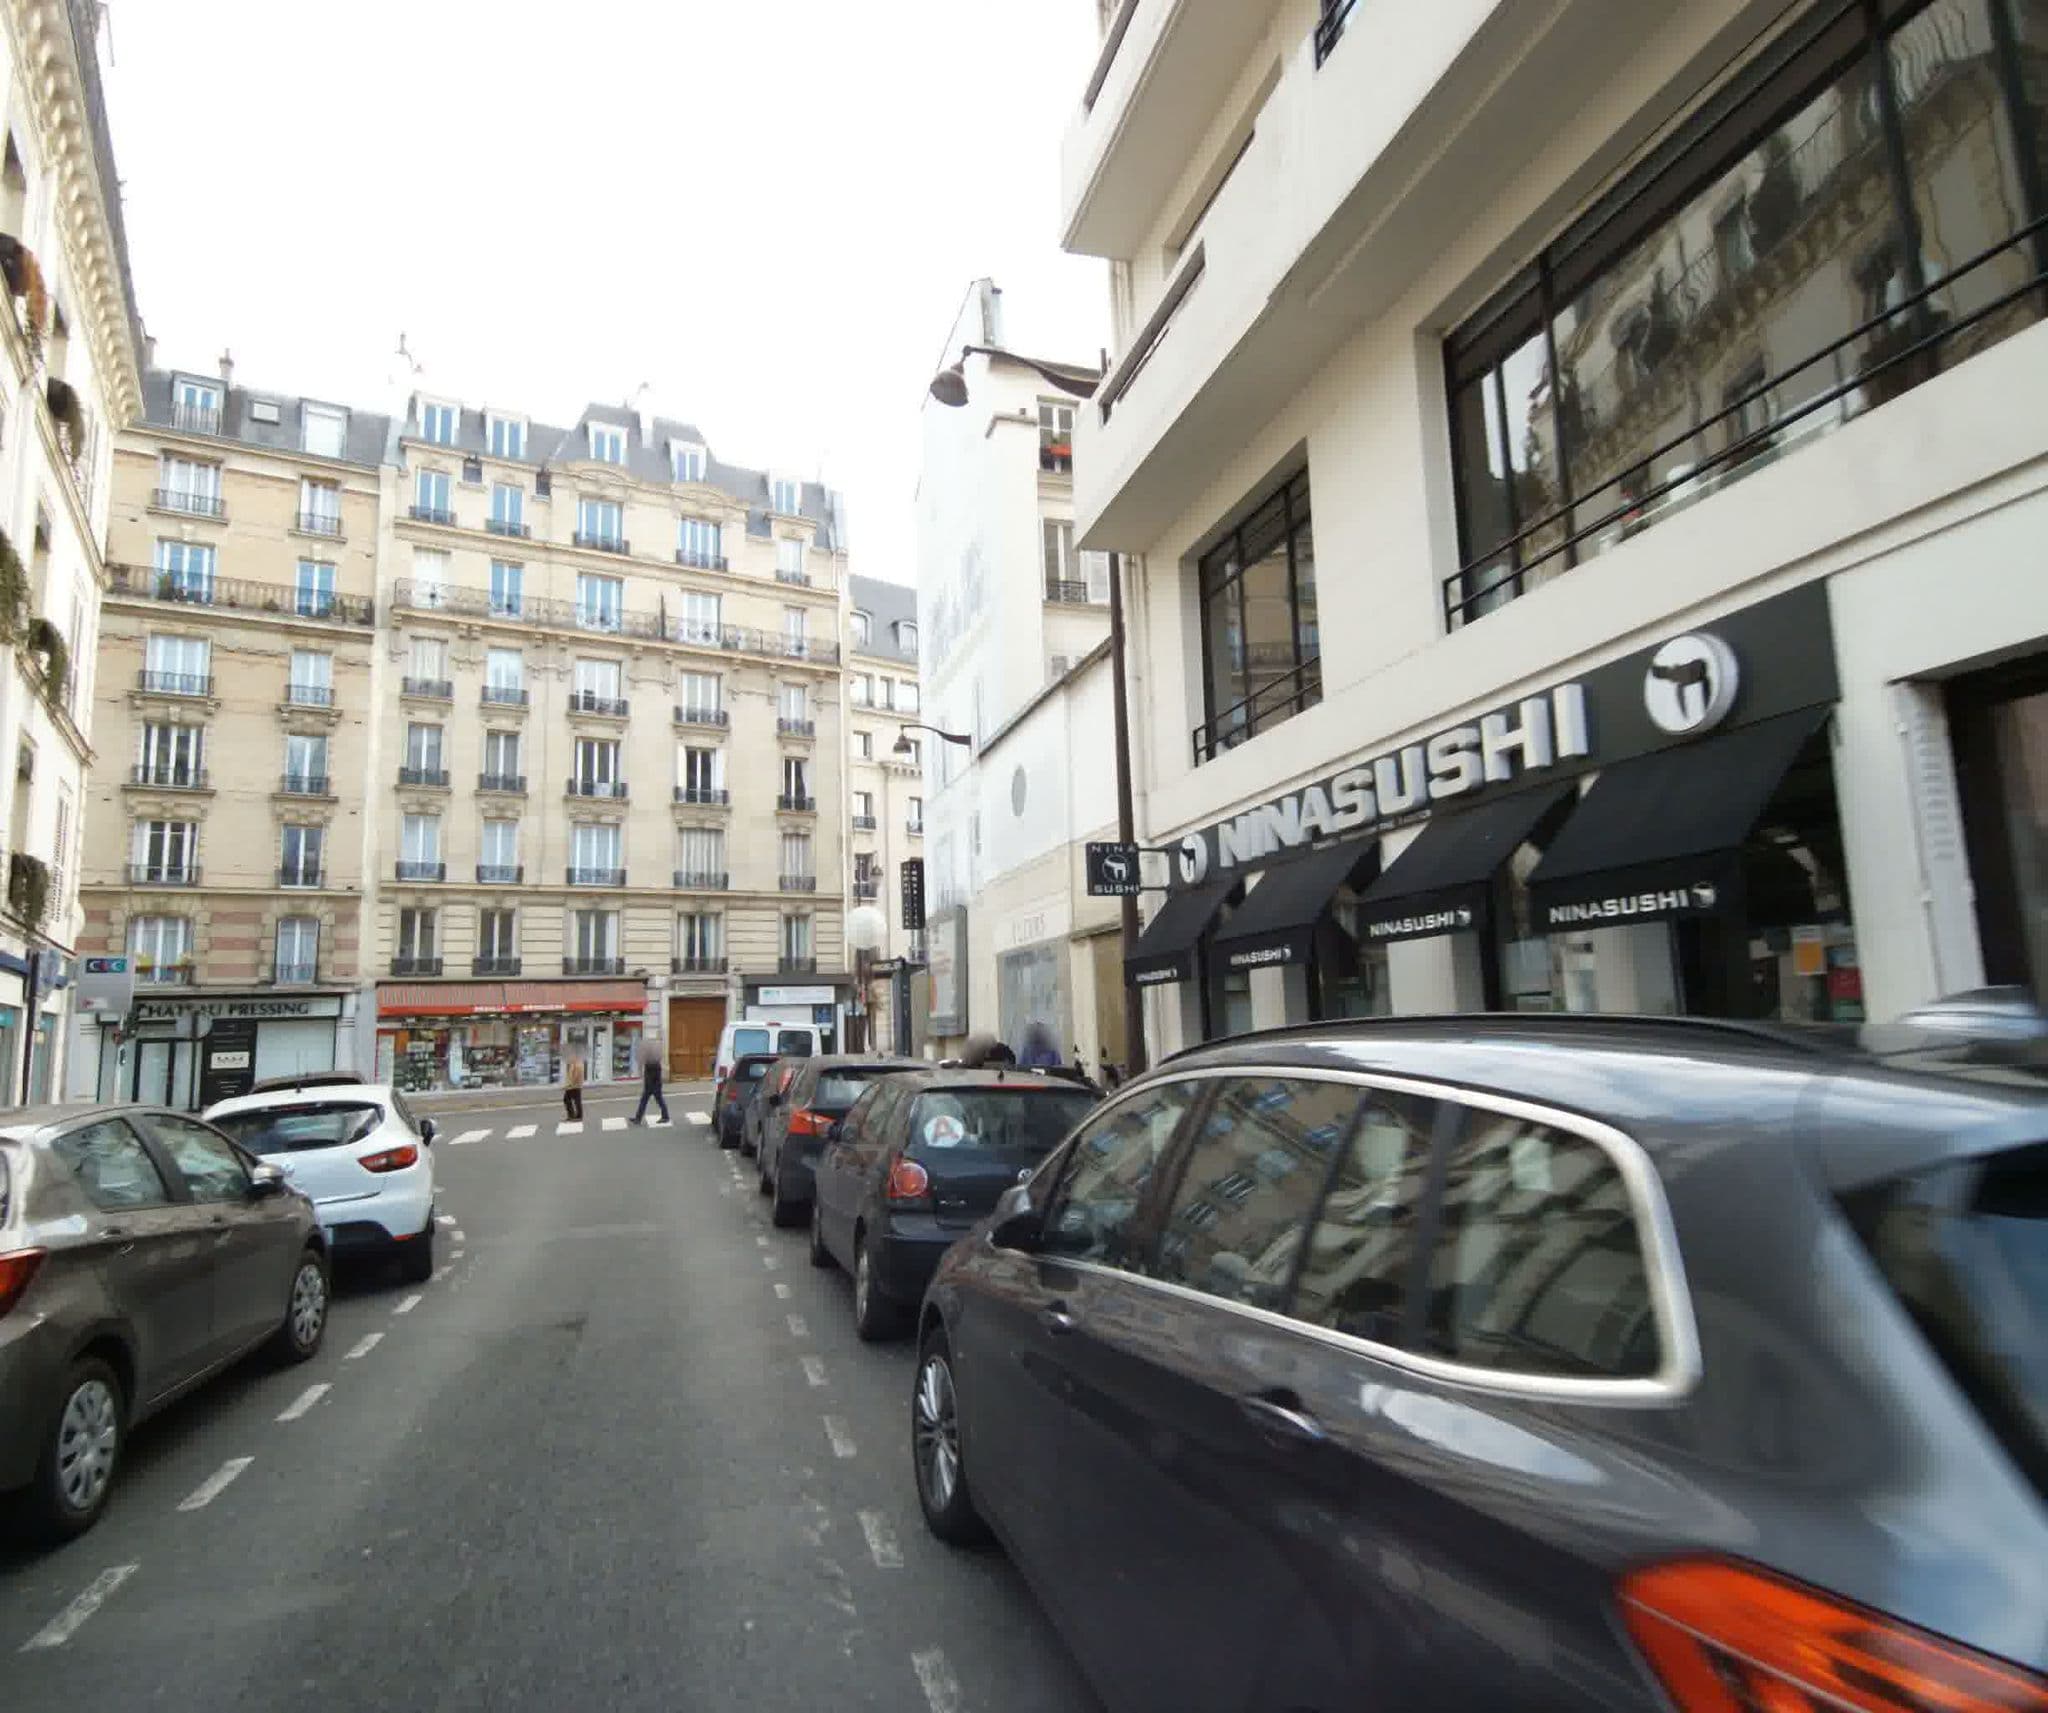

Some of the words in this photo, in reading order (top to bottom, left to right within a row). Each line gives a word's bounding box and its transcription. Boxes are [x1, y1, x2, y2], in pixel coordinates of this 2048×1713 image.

[1218, 683, 1590, 869] NINASUSHI
[1091, 844, 1136, 854] NINA
[1093, 883, 1139, 895] SUSHI
[1549, 889, 1689, 924] NINASUSHI
[1369, 909, 1455, 938] NINASUSHI
[228, 1002, 309, 1016] PRESSING
